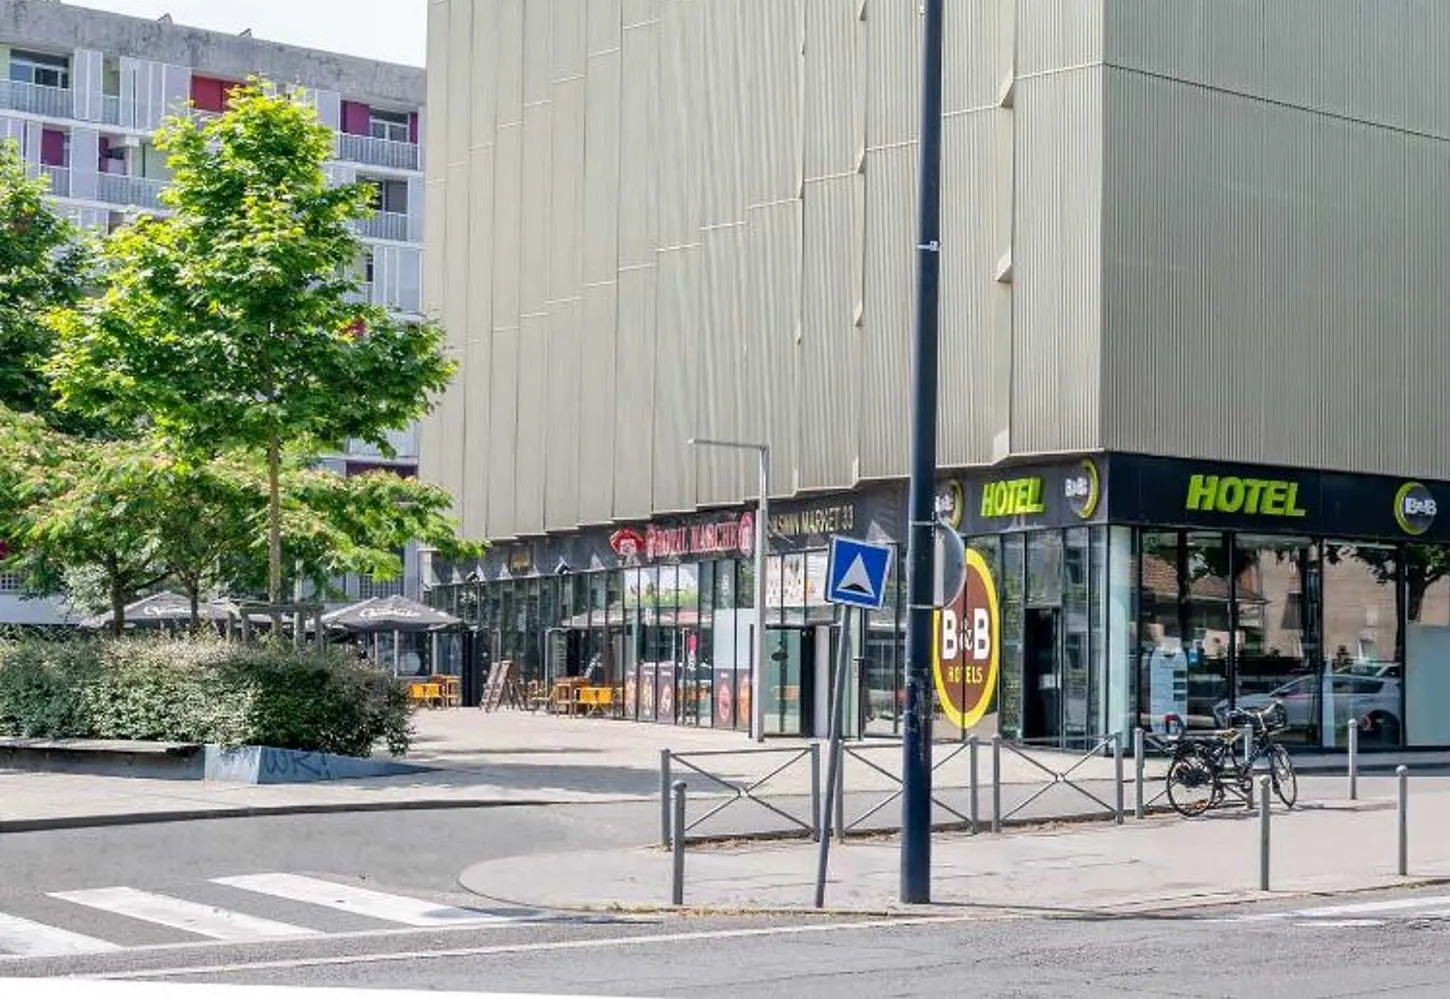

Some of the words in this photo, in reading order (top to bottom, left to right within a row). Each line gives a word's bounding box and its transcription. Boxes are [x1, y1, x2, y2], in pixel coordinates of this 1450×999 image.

[981, 477, 1044, 517] HOTEL
[1186, 474, 1306, 517] HOTEL
[942, 608, 990, 660] B&B
